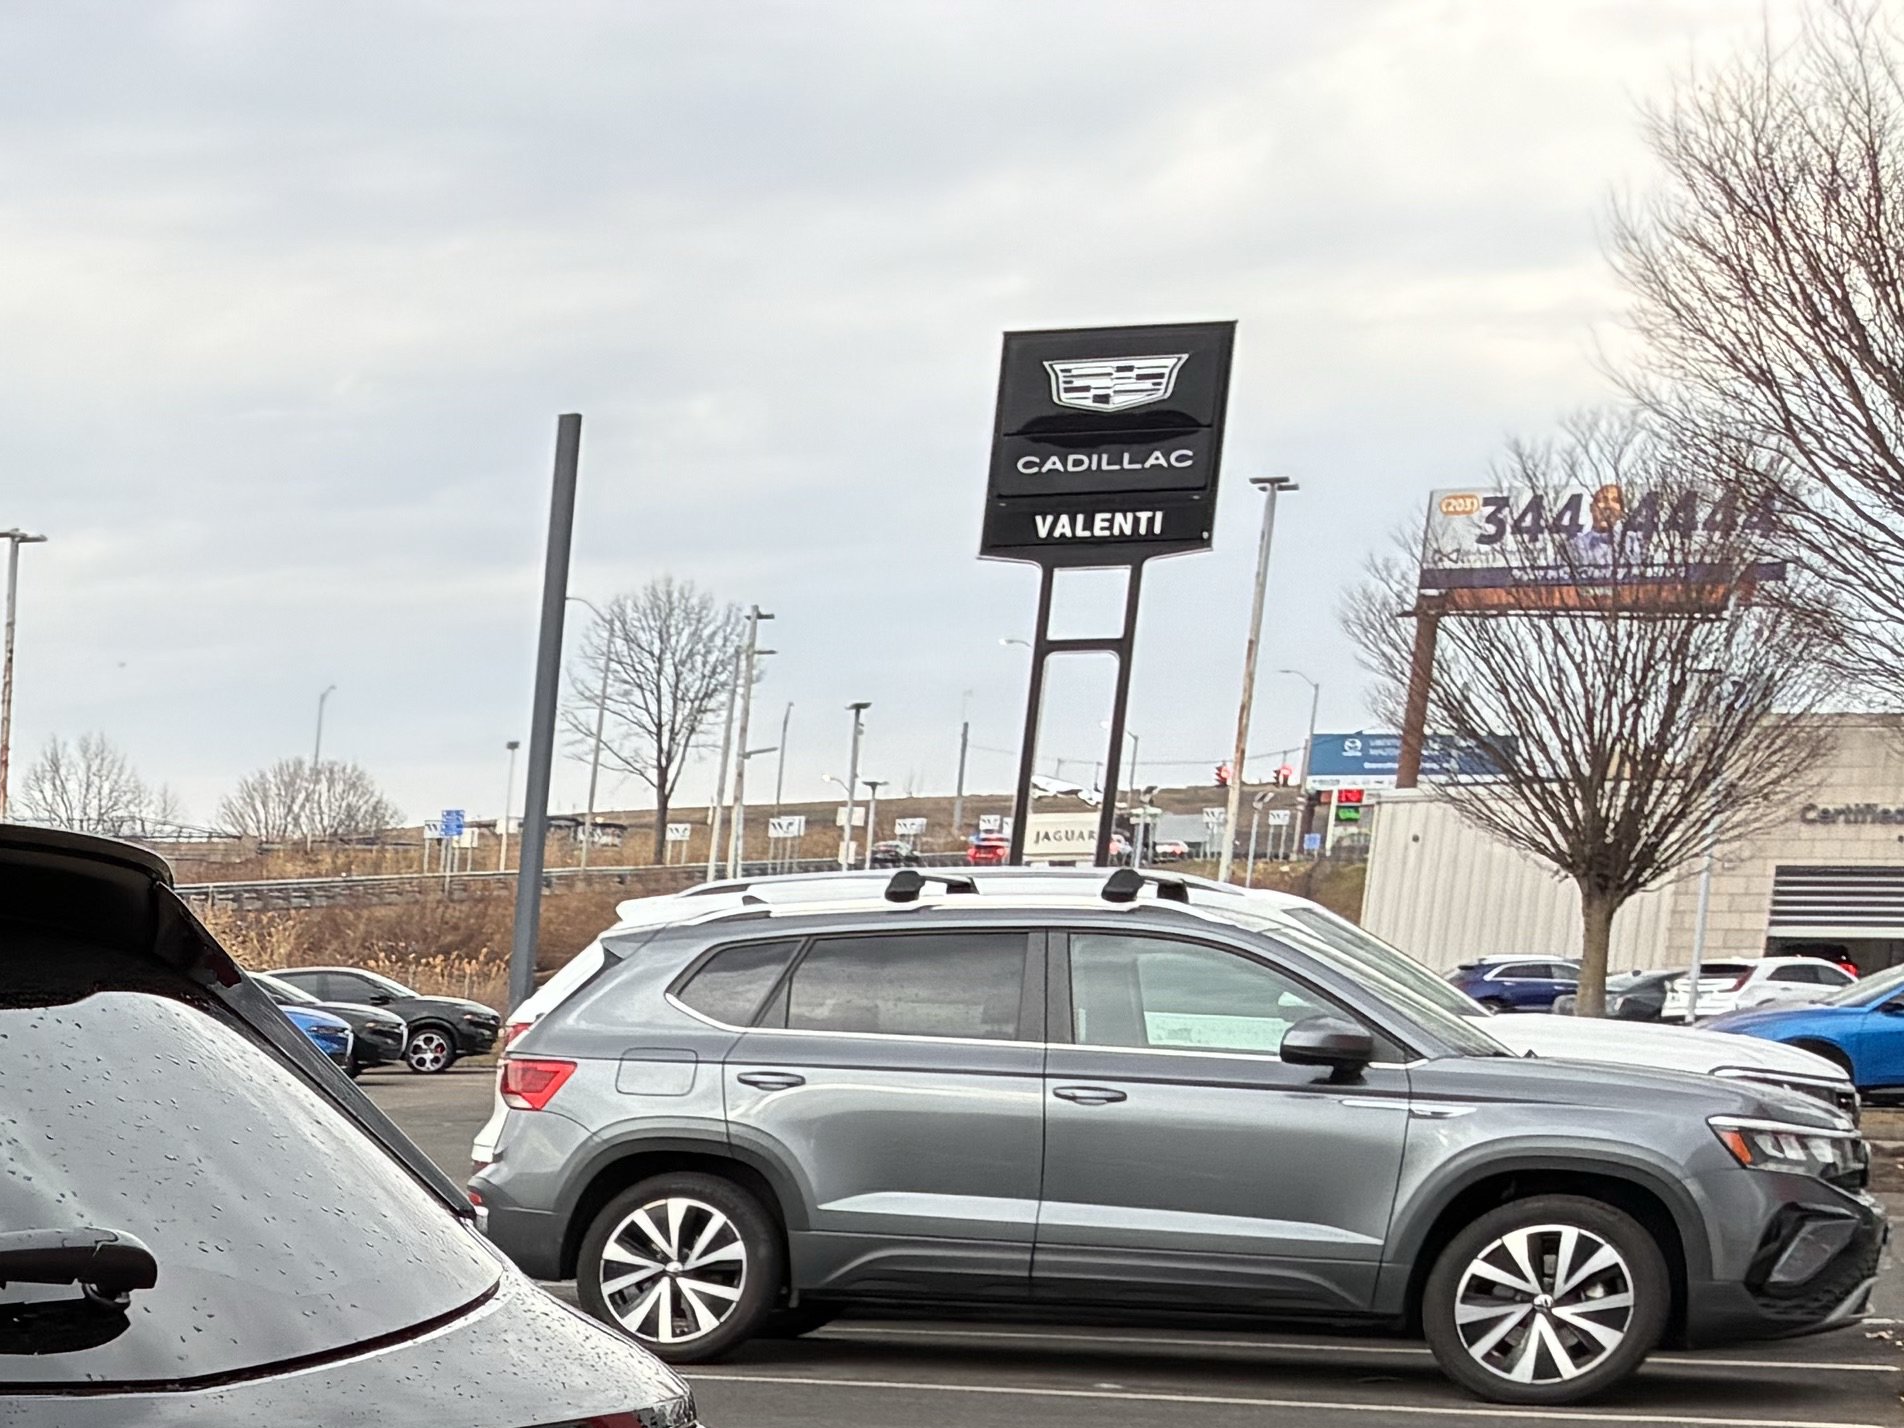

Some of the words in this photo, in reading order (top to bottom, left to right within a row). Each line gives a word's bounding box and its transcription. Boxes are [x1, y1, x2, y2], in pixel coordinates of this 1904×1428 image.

[1016, 448, 1195, 475] CADILLAC
[1034, 510, 1165, 539] VALENTI
[1475, 492, 1585, 547] 344
[1033, 829, 1096, 845] JAGUAR
